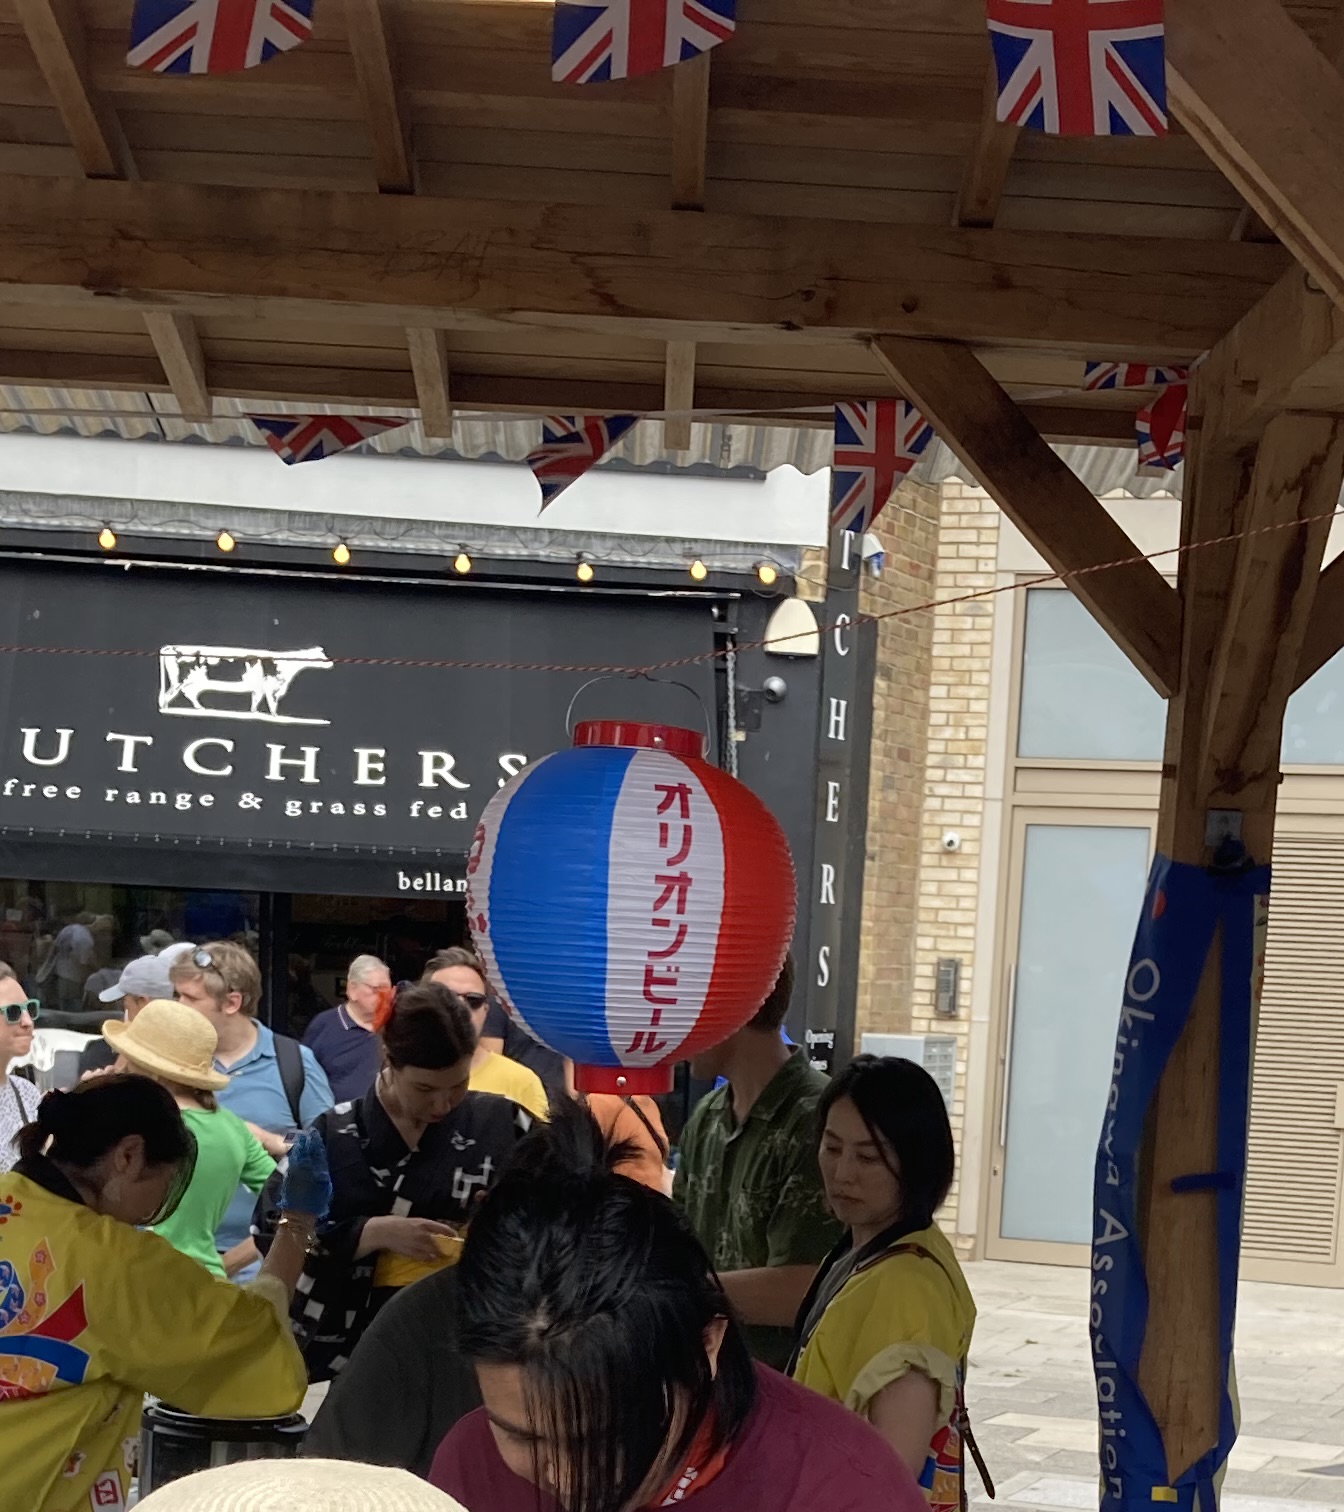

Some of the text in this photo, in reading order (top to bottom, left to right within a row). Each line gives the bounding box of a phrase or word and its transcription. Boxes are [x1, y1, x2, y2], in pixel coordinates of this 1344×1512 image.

[2, 778, 469, 821] free range & grass fed
[817, 529, 856, 987] TCHERS
[625, 782, 693, 1054] オリオンビール
[1105, 958, 1161, 1186] Okinawa
